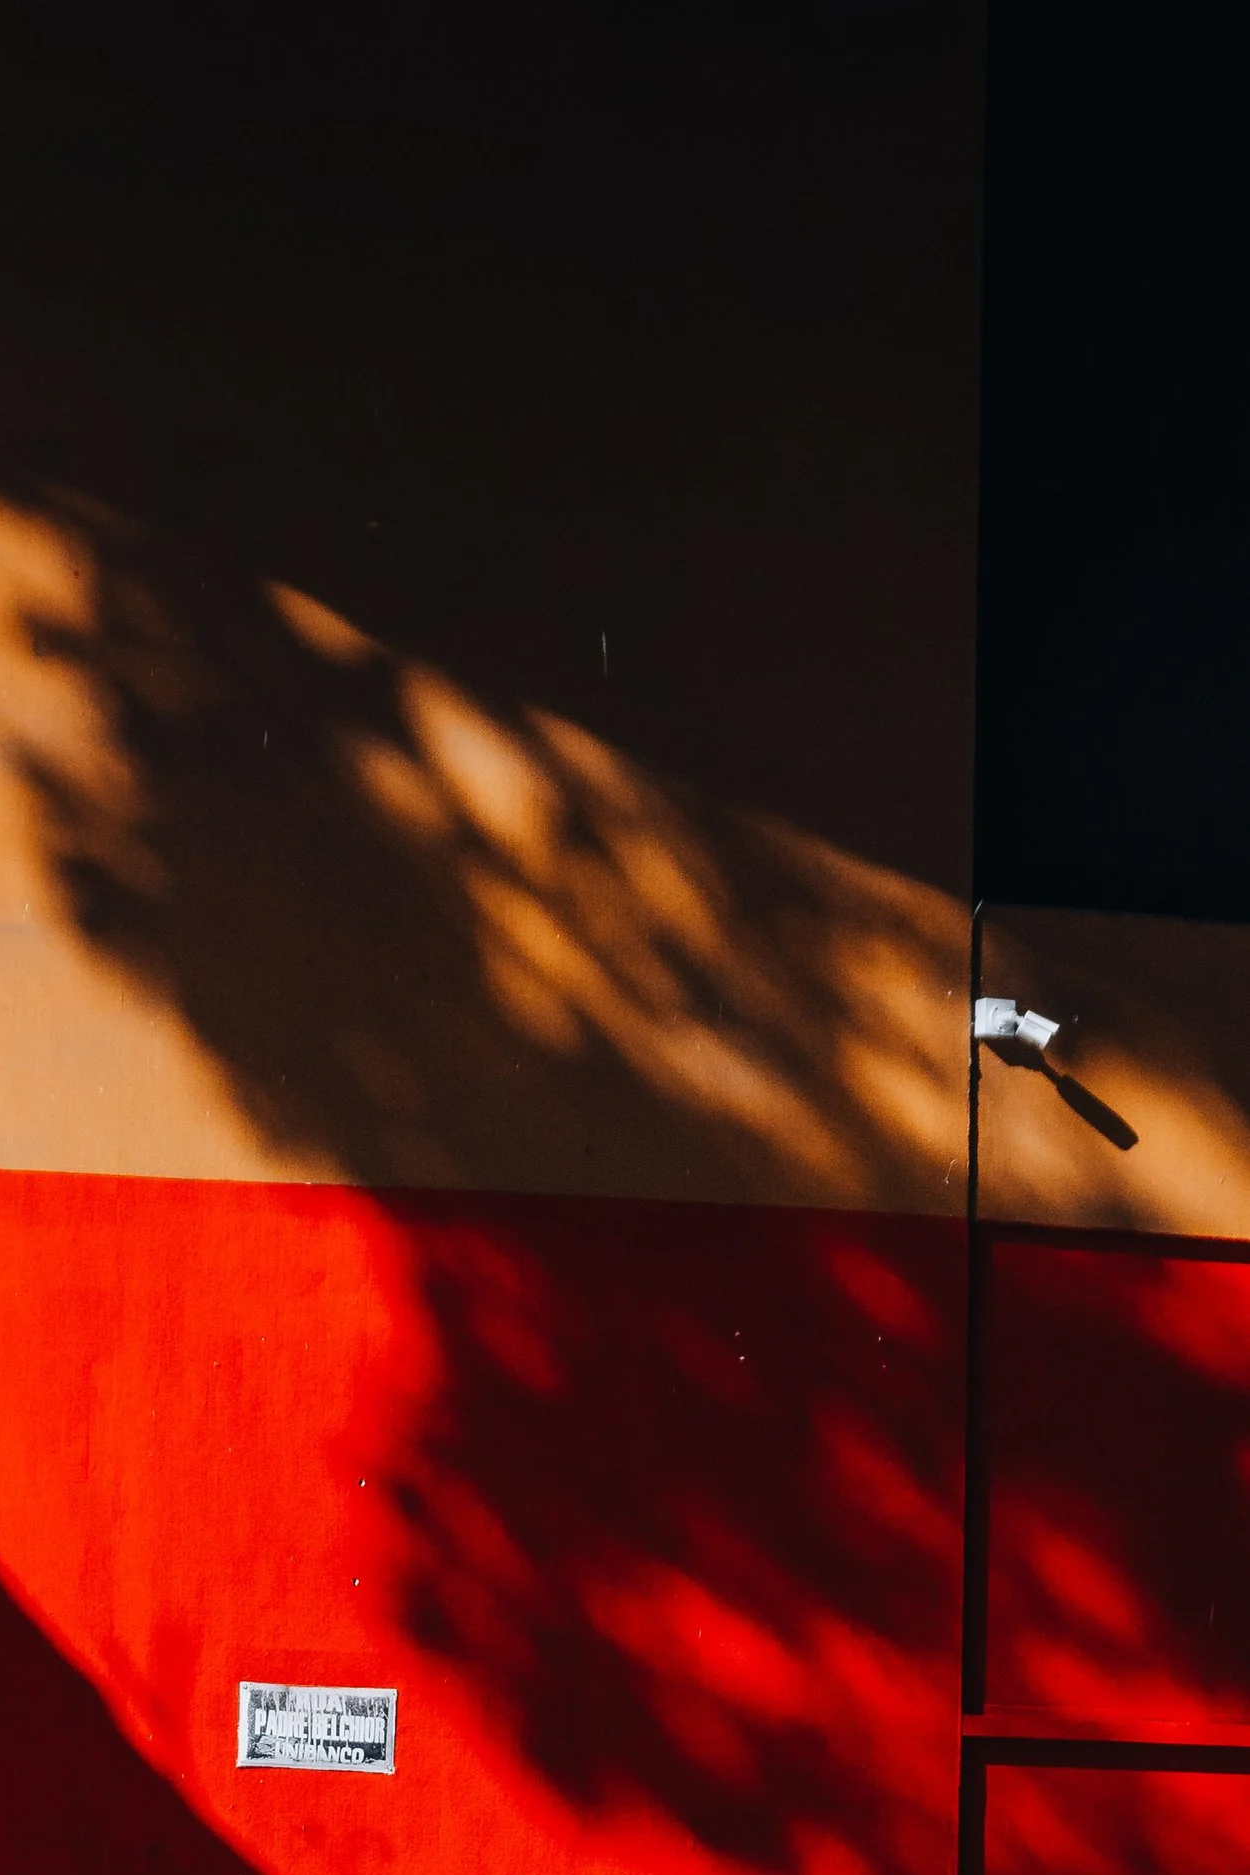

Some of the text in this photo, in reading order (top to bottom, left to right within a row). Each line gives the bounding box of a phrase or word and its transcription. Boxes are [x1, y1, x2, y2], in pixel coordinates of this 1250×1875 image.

[254, 1707, 386, 1744] PADRE BELCHIOR
[275, 1742, 365, 1765] UNIBANCO
